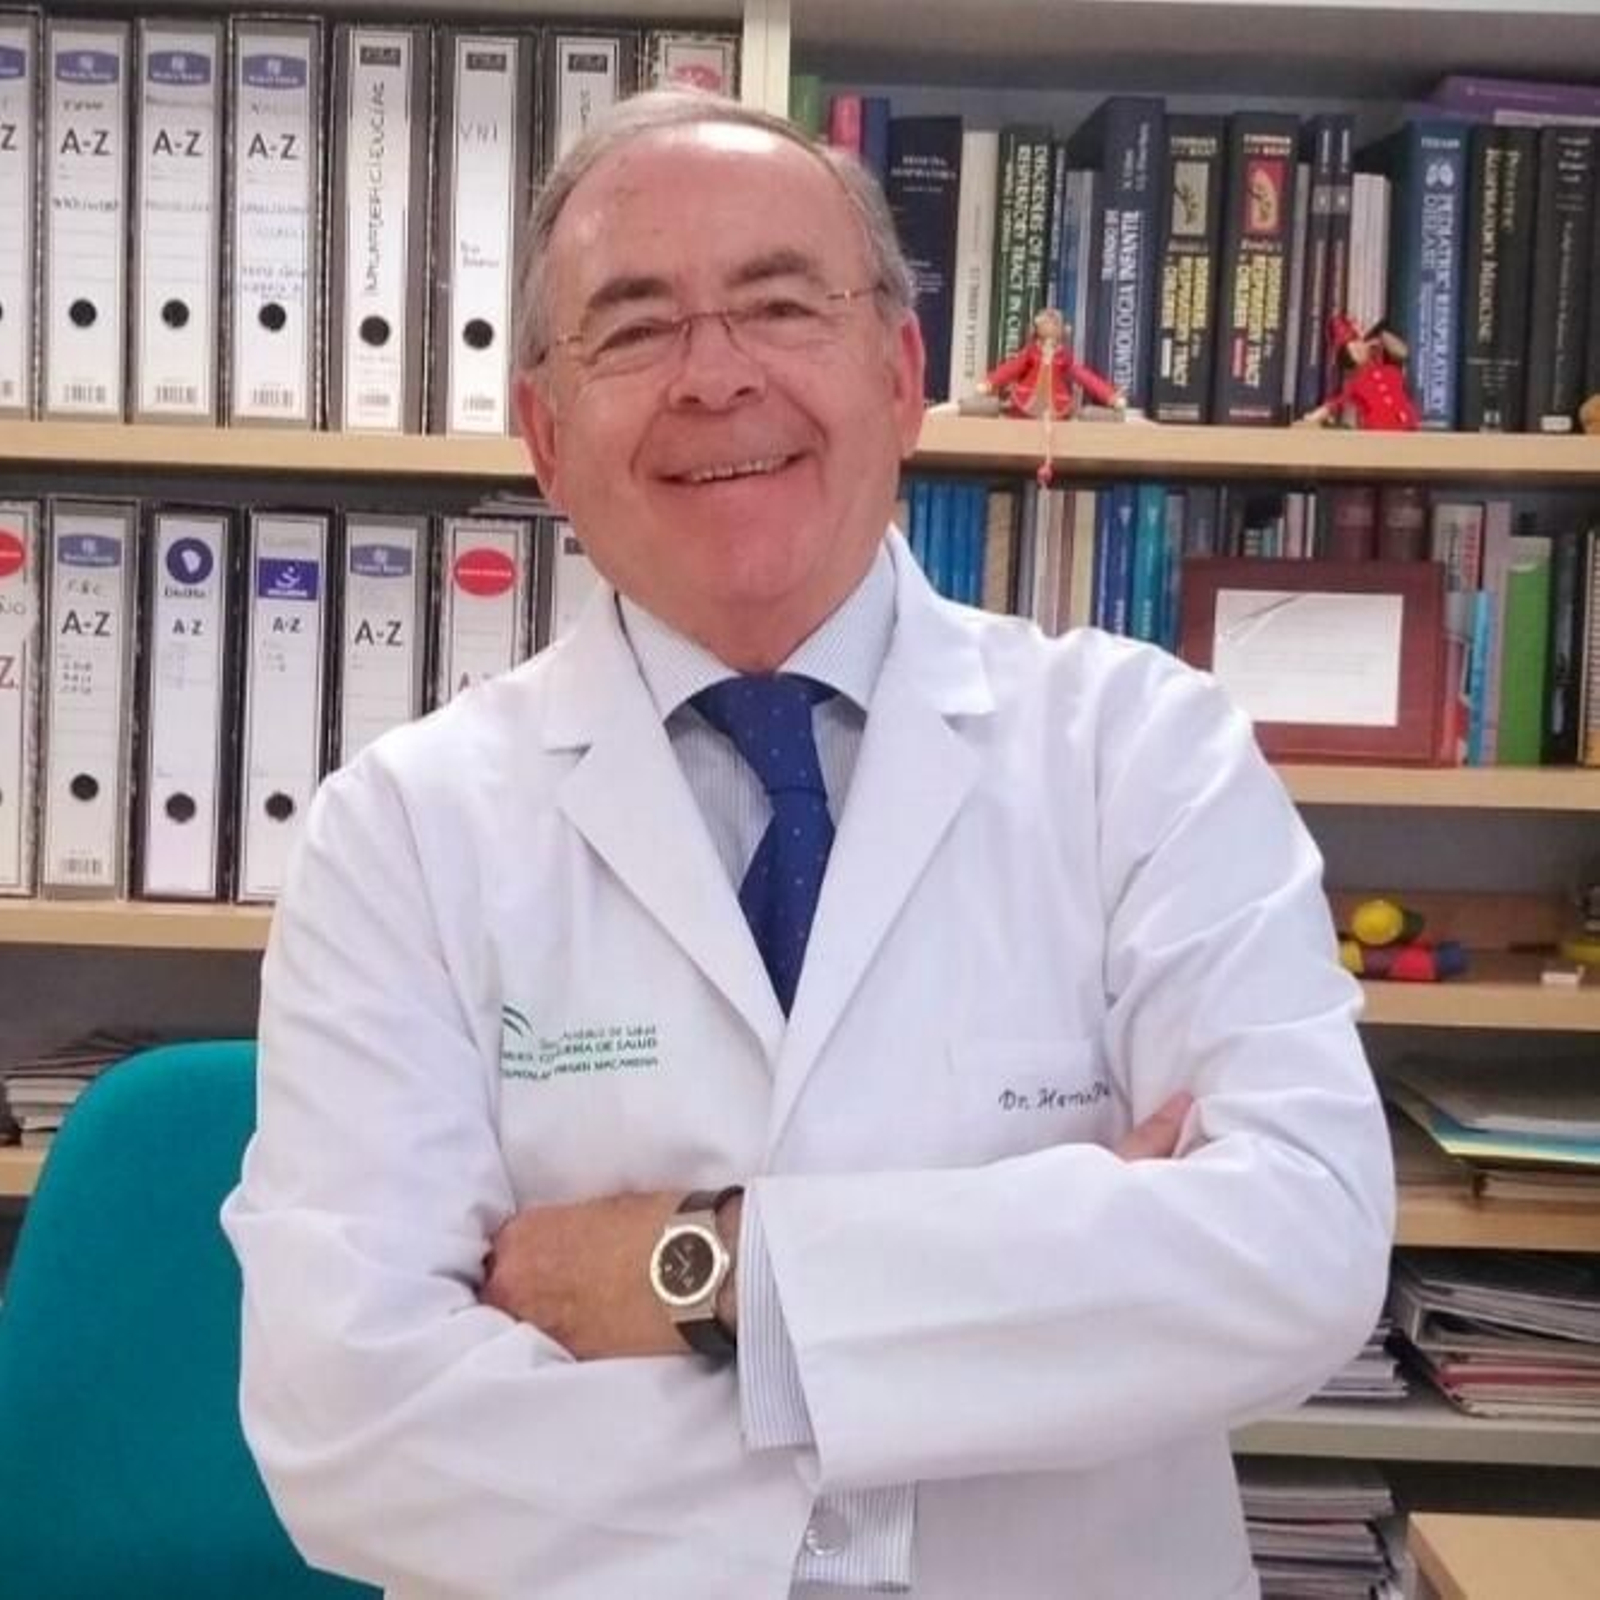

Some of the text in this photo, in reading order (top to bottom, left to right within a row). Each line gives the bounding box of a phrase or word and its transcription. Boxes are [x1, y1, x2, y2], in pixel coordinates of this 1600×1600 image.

[60, 127, 111, 156] A-Z
[152, 128, 203, 156] A-Z
[247, 132, 299, 160] A-Z
[1013, 144, 1031, 239] RESPIRATORY
[1031, 144, 1049, 232] DISORDERS
[1118, 210, 1139, 281] INFANTIL
[1435, 192, 1455, 288] PEDIATRIC
[1009, 246, 1026, 290] TRACT
[1008, 295, 1022, 311] IN
[61, 609, 111, 637] A-Z
[271, 617, 302, 634] A-Z
[354, 620, 403, 646] A-Z
[617, 1037, 657, 1052] SALUD
[998, 1088, 1030, 1111] Dr.
